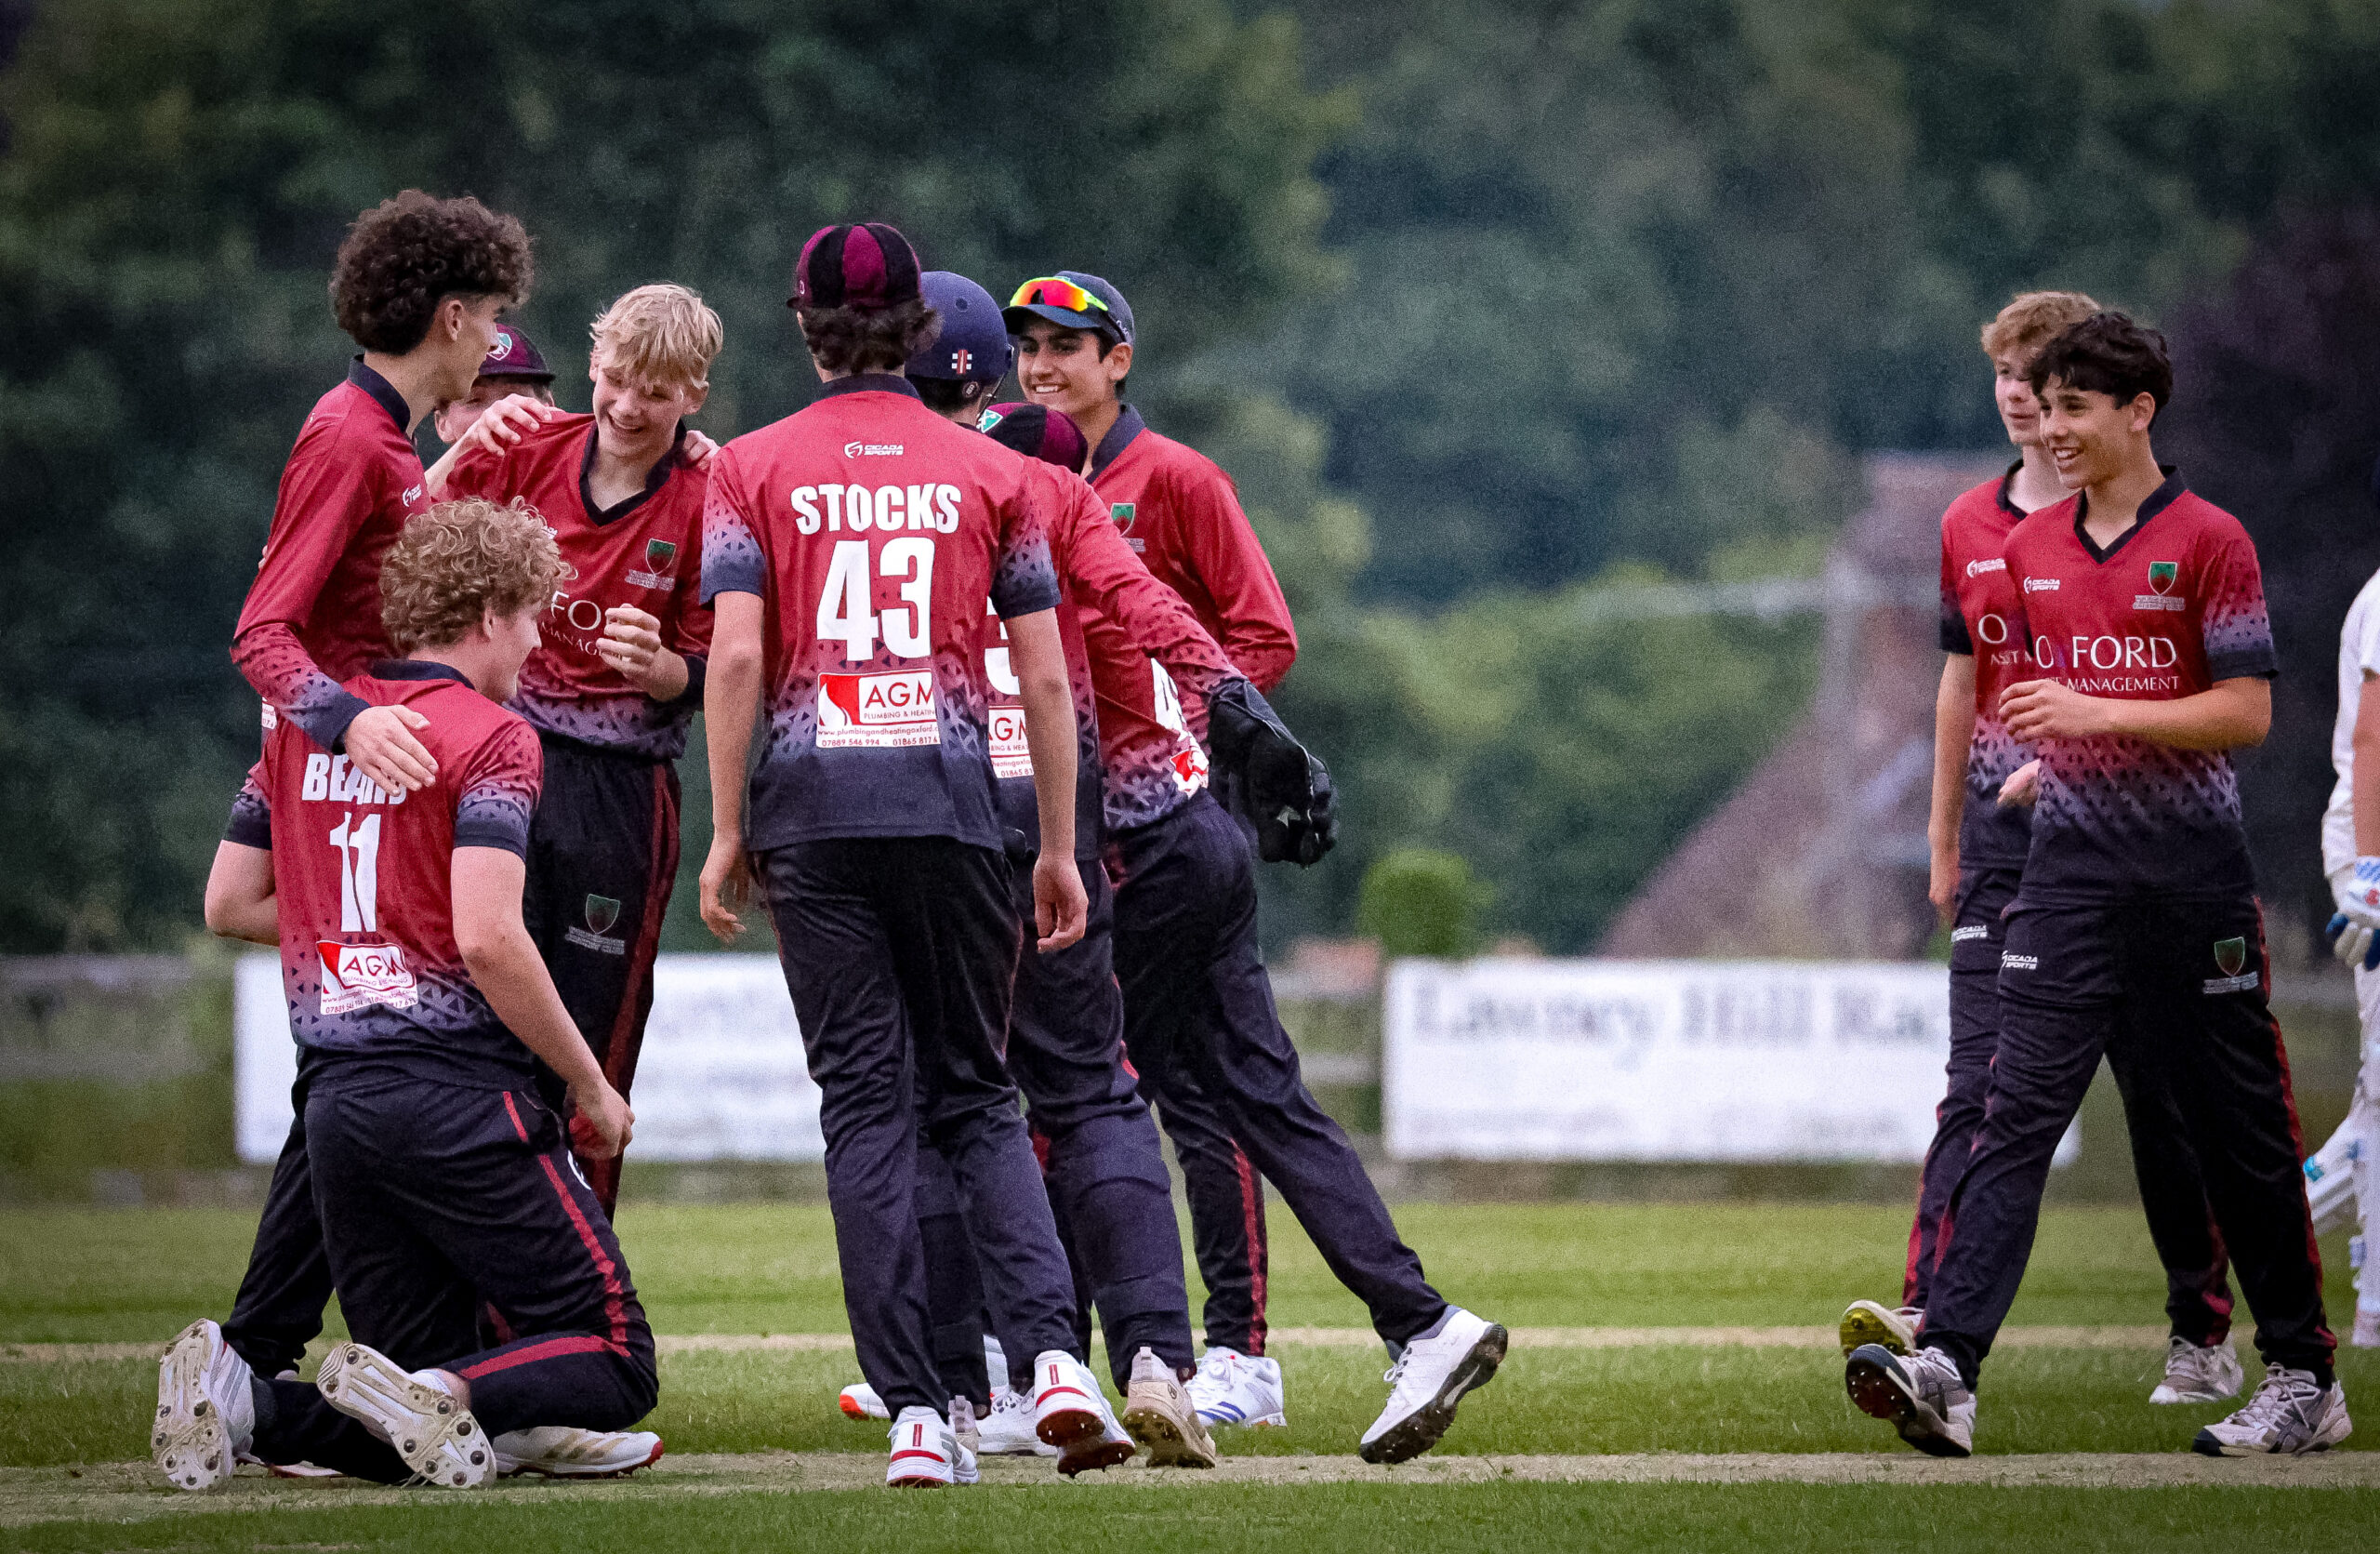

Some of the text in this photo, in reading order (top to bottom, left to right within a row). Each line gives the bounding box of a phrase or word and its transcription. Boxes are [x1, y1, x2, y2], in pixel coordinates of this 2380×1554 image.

[790, 483, 963, 536] STOCKS
[816, 537, 936, 662] 43
[865, 680, 933, 709] AGM
[2067, 676, 2179, 693] MANAGEMENT
[864, 711, 901, 720] PLUMBING
[817, 725, 939, 737] www.plumbingandheatingoxford.c
[329, 811, 381, 933] 11
[343, 954, 405, 976] AGM
